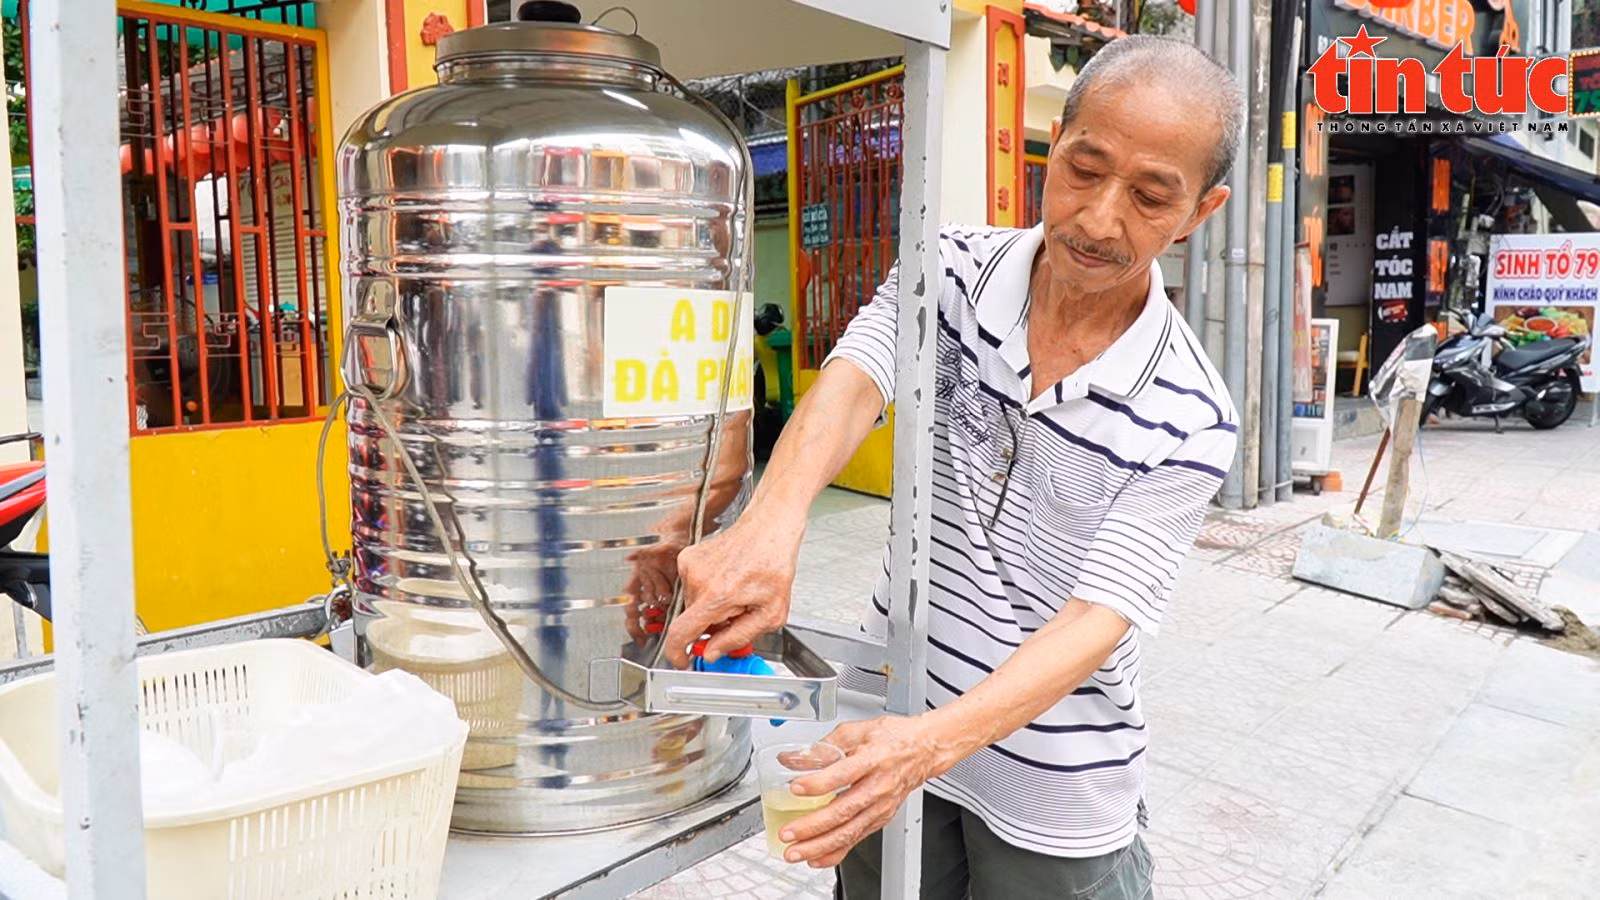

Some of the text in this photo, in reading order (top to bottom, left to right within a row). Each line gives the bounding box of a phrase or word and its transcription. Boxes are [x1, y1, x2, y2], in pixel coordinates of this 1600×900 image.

[1375, 225, 1414, 250] CẮT
[1375, 254, 1413, 276] TÓC
[1495, 239, 1600, 279] SINH TỐ 79
[1374, 281, 1413, 299] NAM
[1494, 284, 1598, 303] KÍNH CHÀO QUÝ KHÁCH
[671, 298, 696, 342] A
[612, 348, 679, 403] ĐÀ
